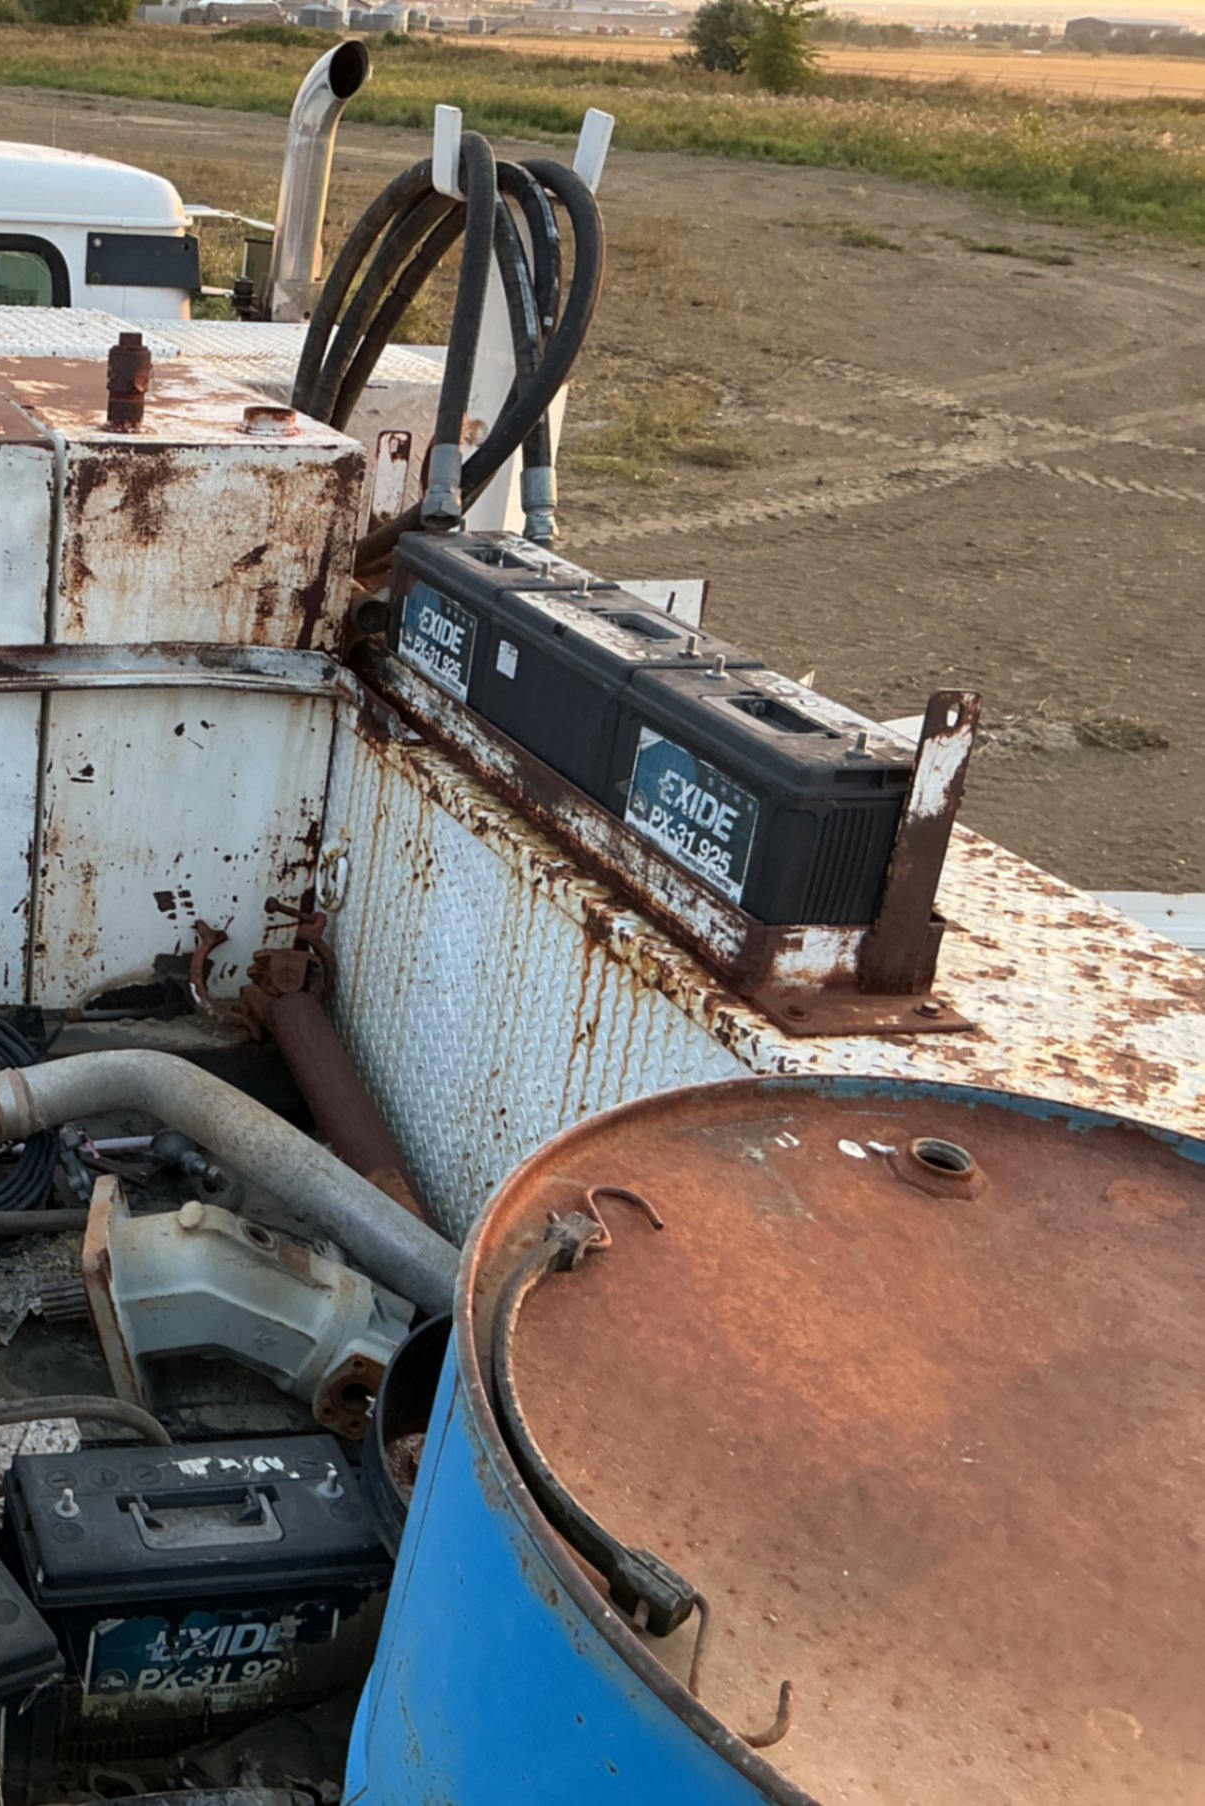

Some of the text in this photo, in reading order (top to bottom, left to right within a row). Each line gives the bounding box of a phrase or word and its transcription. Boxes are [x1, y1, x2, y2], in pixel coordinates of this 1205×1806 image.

[418, 605, 466, 655] EXIDE
[658, 769, 740, 843] EXIDE
[649, 805, 732, 877] PX-31 925
[242, 1658, 294, 1683] 92
